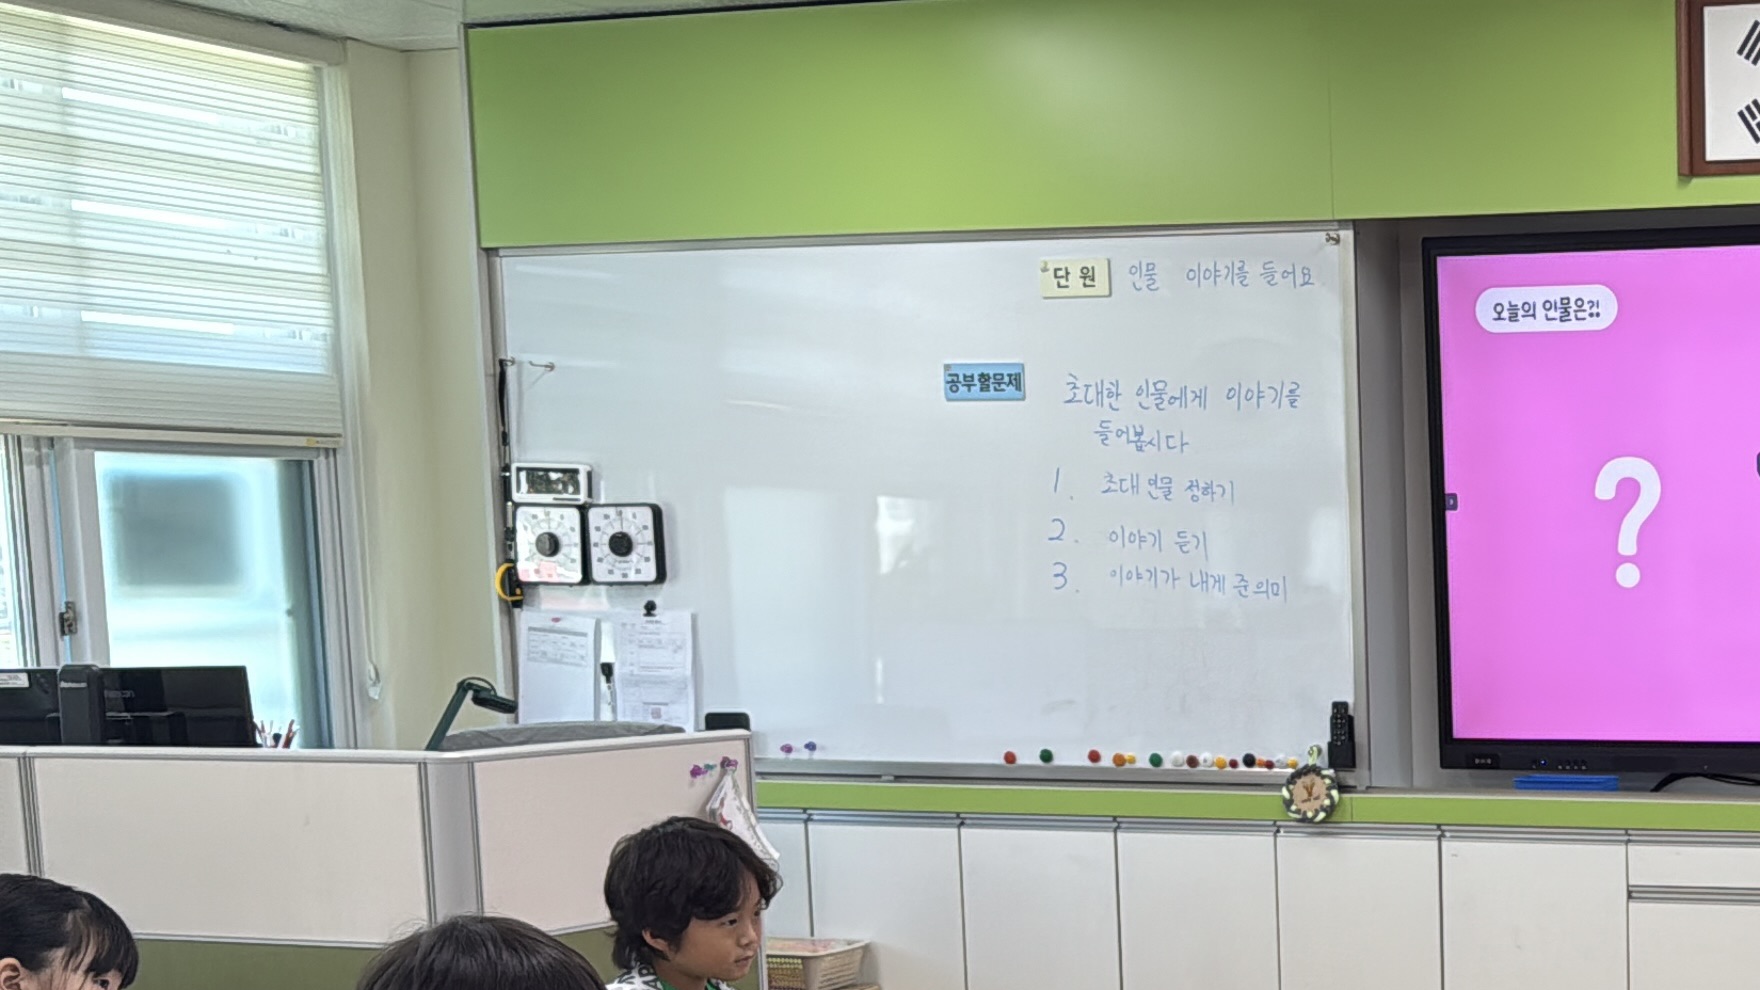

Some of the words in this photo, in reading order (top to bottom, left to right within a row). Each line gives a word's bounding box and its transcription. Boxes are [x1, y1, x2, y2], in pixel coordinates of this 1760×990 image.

[1129, 262, 1160, 292] 인물
[1186, 260, 1250, 289] 이야기를
[1259, 261, 1315, 287] 들어요
[1492, 300, 1537, 322] 오늘의
[1542, 296, 1601, 323] 인물은?!
[945, 371, 1022, 393] 공부할문제
[1063, 373, 1123, 411] 초대한
[1135, 378, 1208, 412] 인물에게
[1225, 380, 1301, 410] 이야기를
[1093, 420, 1190, 454] 들어봅시다
[1101, 472, 1139, 495] 초대
[1147, 475, 1173, 501] 인물
[1184, 478, 1236, 503] 정하기
[1048, 518, 1080, 543] 2.
[1109, 526, 1163, 551] 이야기
[1174, 530, 1209, 561] 듣기
[1052, 562, 1080, 593] 3.
[1109, 566, 1181, 592] 이야기가
[1189, 571, 1226, 594] 내게
[1232, 573, 1250, 599] 준
[1253, 576, 1288, 602] 의미
